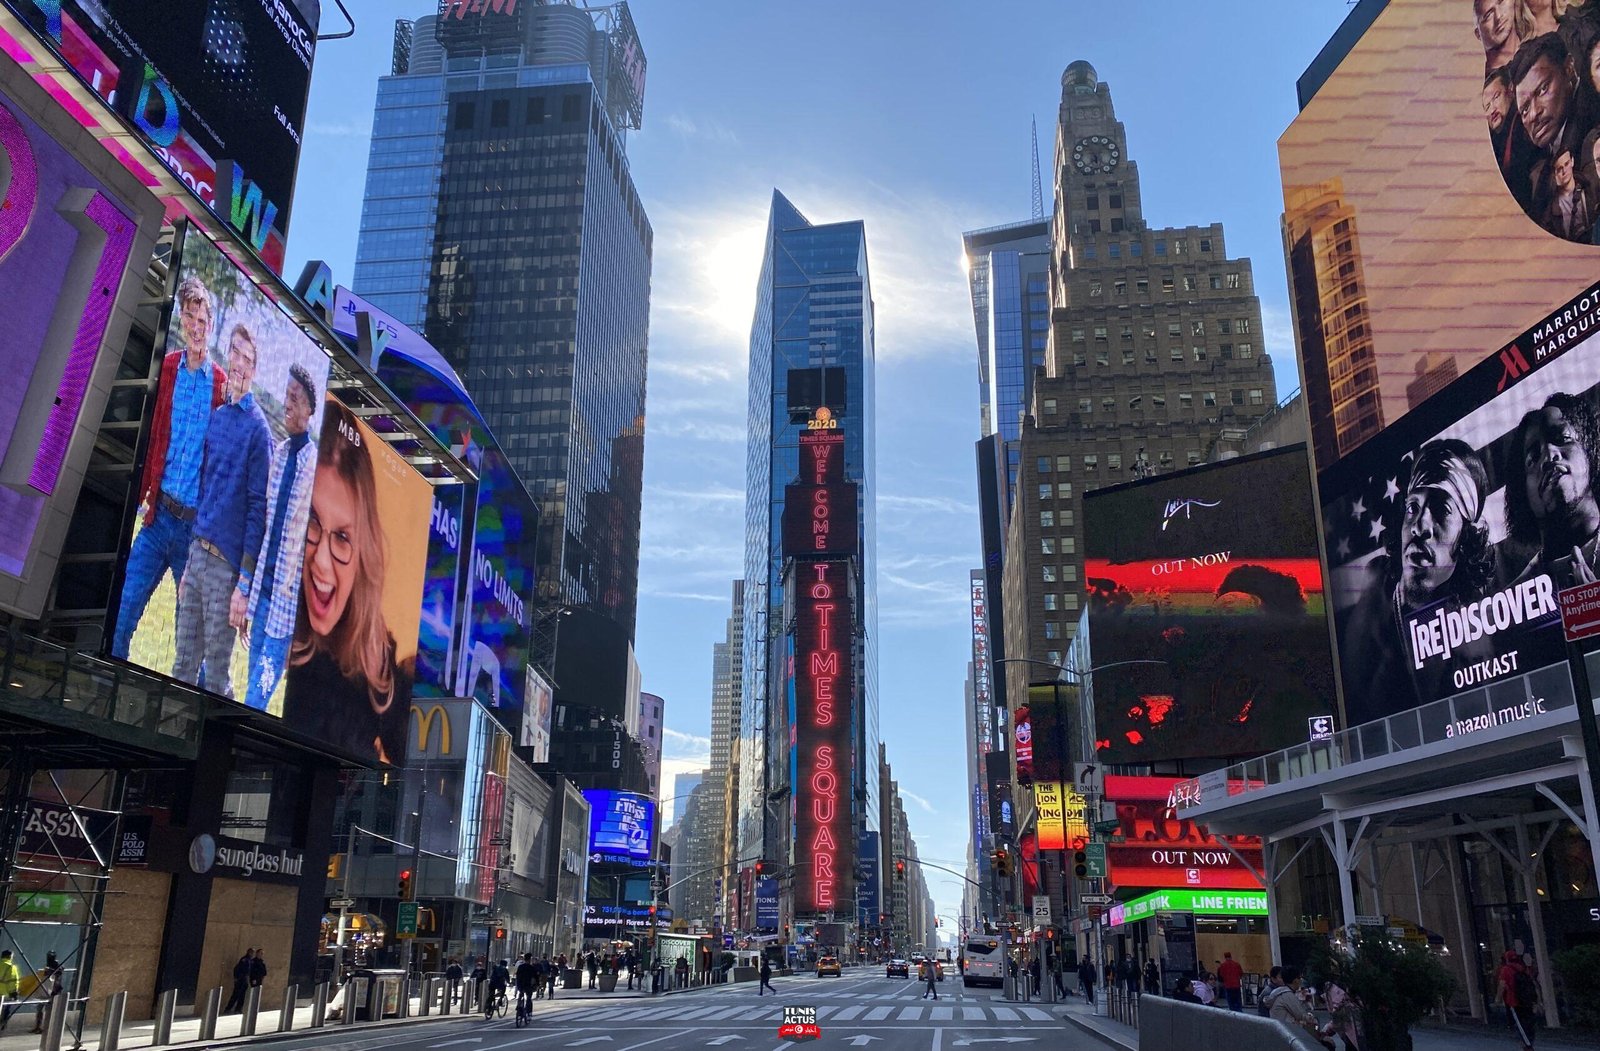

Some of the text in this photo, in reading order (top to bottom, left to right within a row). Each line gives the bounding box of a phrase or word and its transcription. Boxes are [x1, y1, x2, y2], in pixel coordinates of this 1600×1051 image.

[274, 15, 292, 44] Array
[273, 104, 287, 127] Full
[1535, 307, 1600, 361] MARQUIS
[337, 419, 361, 447] MBB
[808, 419, 837, 430] 2020
[430, 494, 459, 549] HAS
[475, 548, 493, 589] NO
[1151, 550, 1232, 576] OUT NOW
[1562, 585, 1600, 606] NO STOP
[1565, 600, 1600, 617] Anytime
[1409, 573, 1558, 670] [RE]DISCOVER
[811, 445, 838, 908] WELCOME TO TIMES SQUARE
[1453, 650, 1519, 689] OUTKAST
[612, 731, 621, 769] 1500
[1036, 793, 1057, 806] LION
[1036, 806, 1061, 820] KING
[121, 840, 145, 849] POLO
[123, 832, 138, 841] U.S.
[215, 844, 304, 877] sunglass hut
[1152, 850, 1232, 866] OUT NOW
[1035, 907, 1049, 916] 25
[1192, 896, 1268, 910] LINE FRIEN
